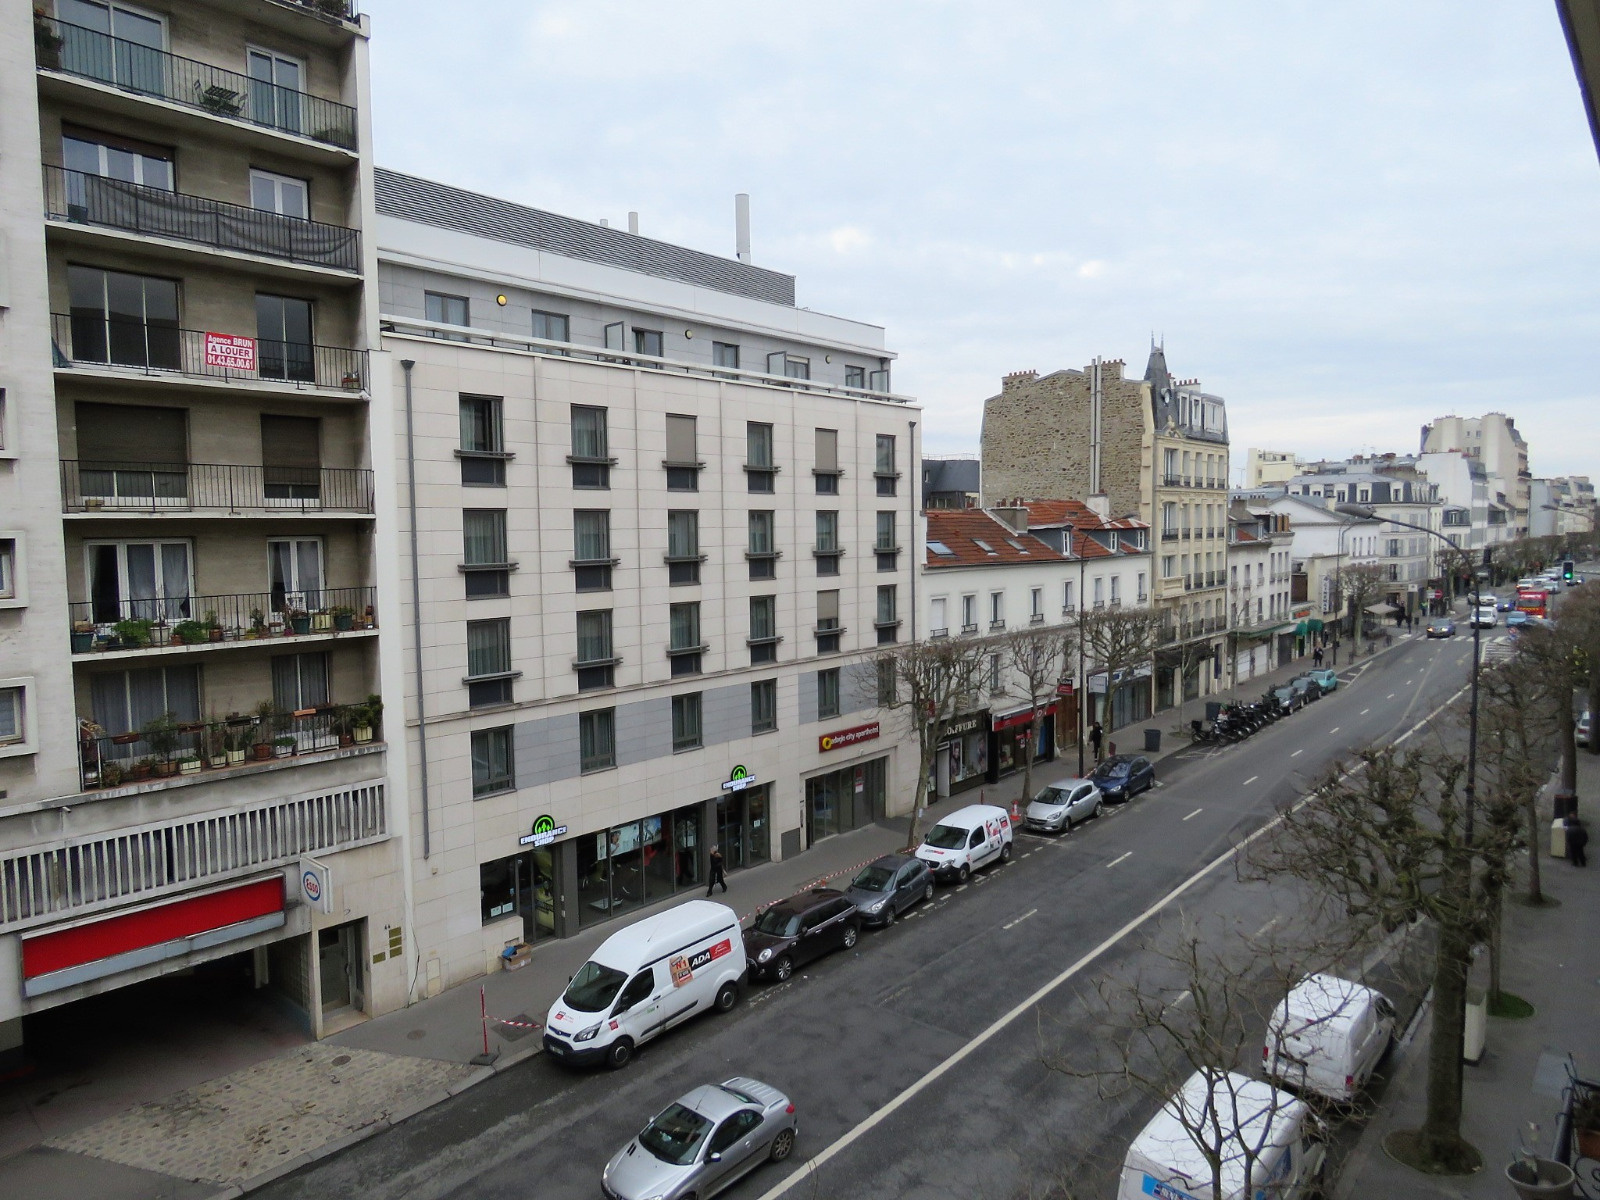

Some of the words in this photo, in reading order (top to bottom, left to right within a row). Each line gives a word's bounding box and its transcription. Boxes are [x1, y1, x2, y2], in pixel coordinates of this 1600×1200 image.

[208, 334, 232, 345] Agence
[233, 337, 253, 348] BRUN
[211, 344, 217, 353] A
[220, 346, 250, 357] LOUER
[520, 826, 567, 845] ENDURANCE
[534, 836, 555, 847] SHOP
[691, 951, 711, 967] ADA
